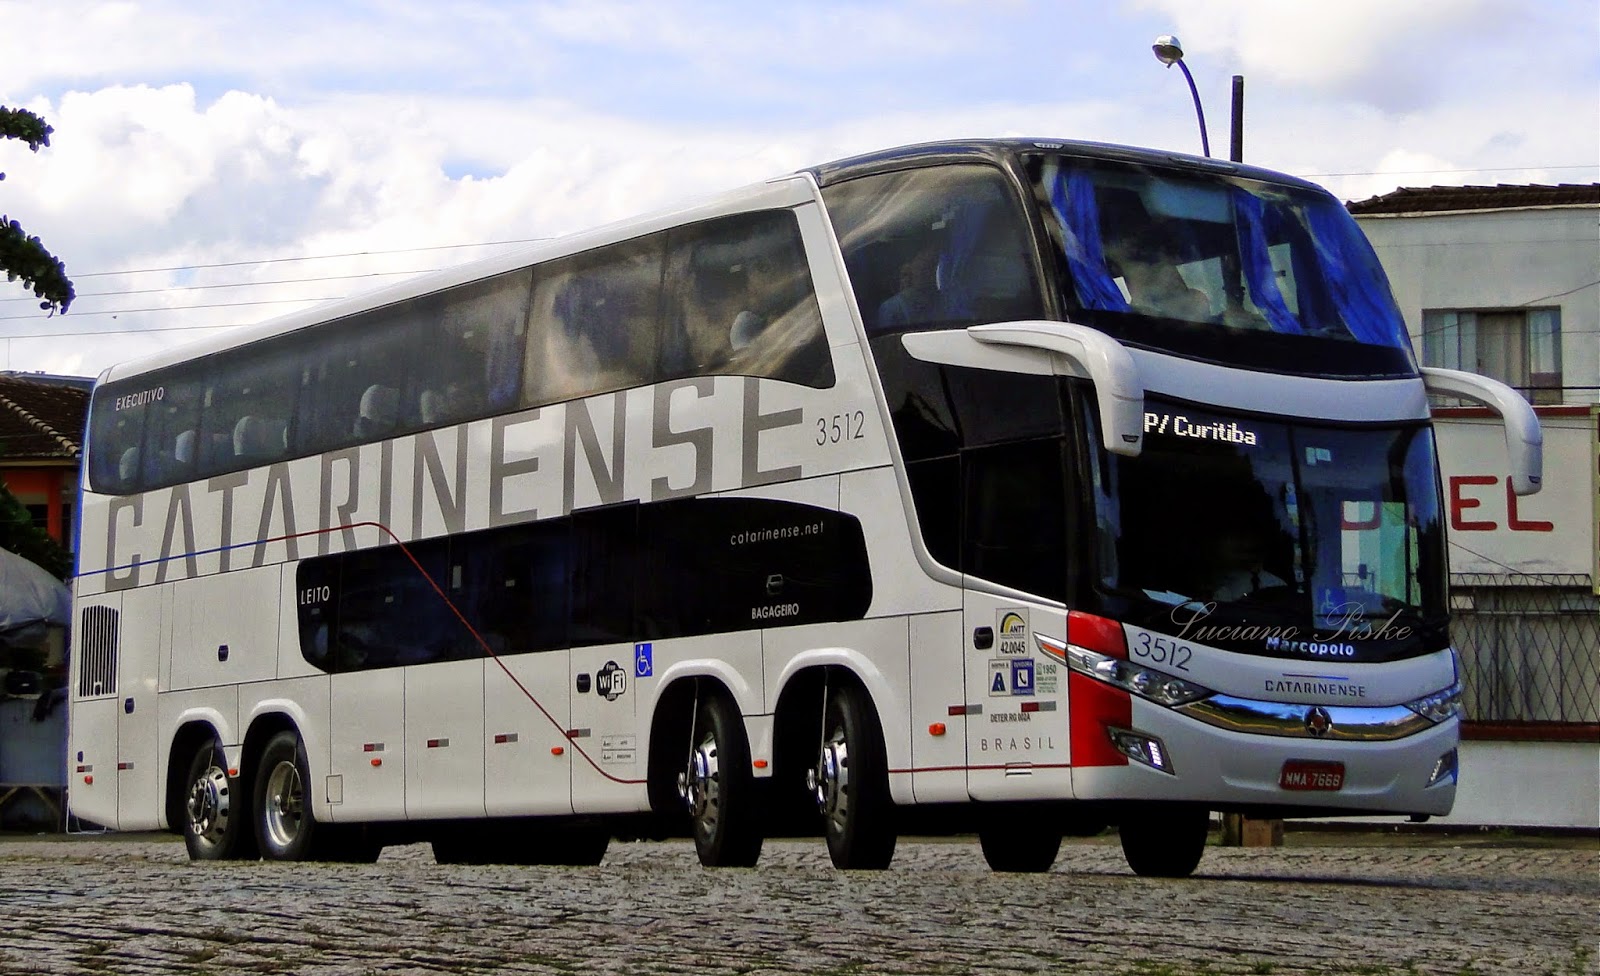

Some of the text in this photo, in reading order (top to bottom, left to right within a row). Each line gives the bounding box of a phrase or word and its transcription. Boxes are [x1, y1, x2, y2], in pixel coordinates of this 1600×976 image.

[115, 386, 165, 412] EXECUTIVO
[816, 410, 865, 446] 3512
[1143, 412, 1257, 446] P/ Curitiba
[105, 374, 804, 593] CATARINENSE
[730, 521, 824, 546] catarinense.net
[300, 585, 331, 605] LEITO
[751, 603, 800, 620] BAGAGEIRO
[1009, 625, 1026, 634] ANTT
[1133, 632, 1193, 672] 3512
[1265, 636, 1355, 657] Marcopolo
[1264, 680, 1366, 698] CATARINENSE
[981, 736, 1055, 752] BRASIL
